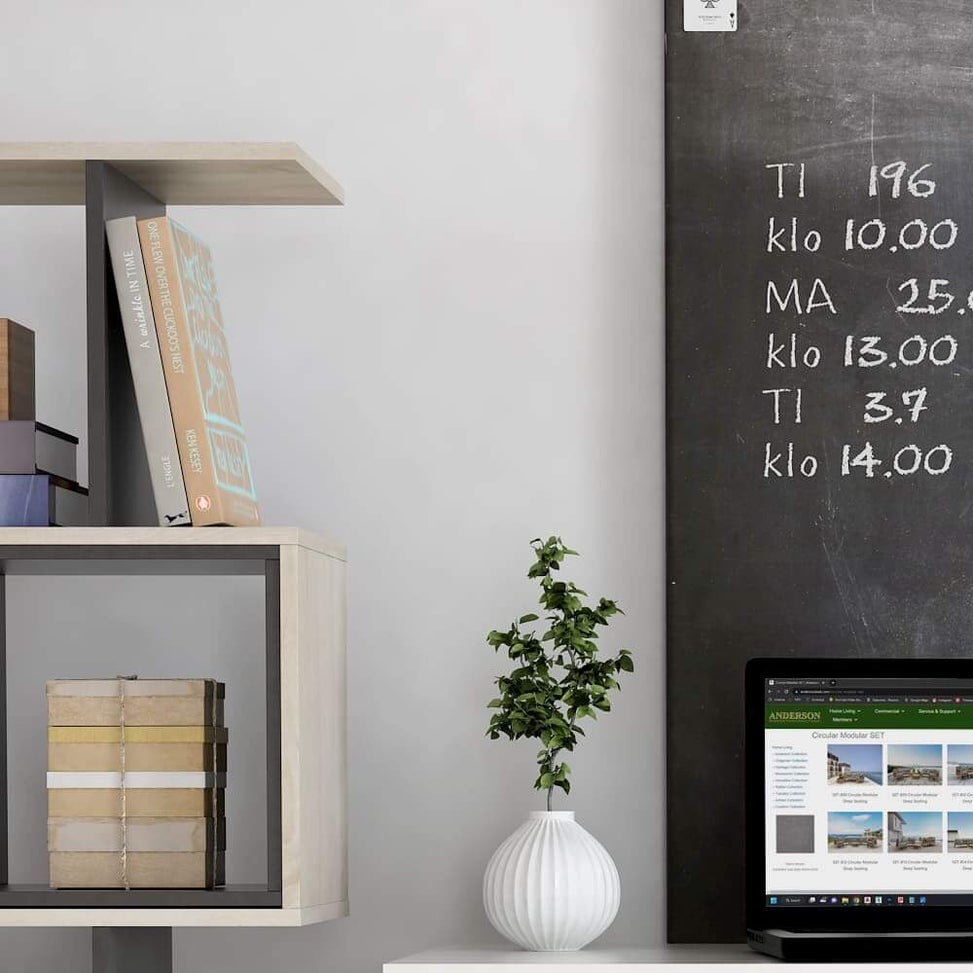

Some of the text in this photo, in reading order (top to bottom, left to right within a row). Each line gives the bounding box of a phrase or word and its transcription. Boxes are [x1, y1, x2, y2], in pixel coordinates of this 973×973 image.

[868, 161, 936, 198] 196
[147, 221, 160, 240] ONE
[766, 217, 959, 253] klo 10.00
[151, 241, 165, 265] FLEW
[155, 266, 169, 289] OVER
[122, 250, 151, 349] A wrinkle IN TIME
[159, 289, 172, 307] THE
[765, 278, 837, 314] MA
[170, 353, 184, 375] NEST
[766, 333, 958, 370] klo 13.00
[863, 387, 929, 425] 3.7
[186, 428, 203, 473] KEN KESEY
[763, 441, 953, 479] klo 14.00
[768, 711, 821, 720] ANDERSON
[811, 731, 885, 739] Circular Modular SET
